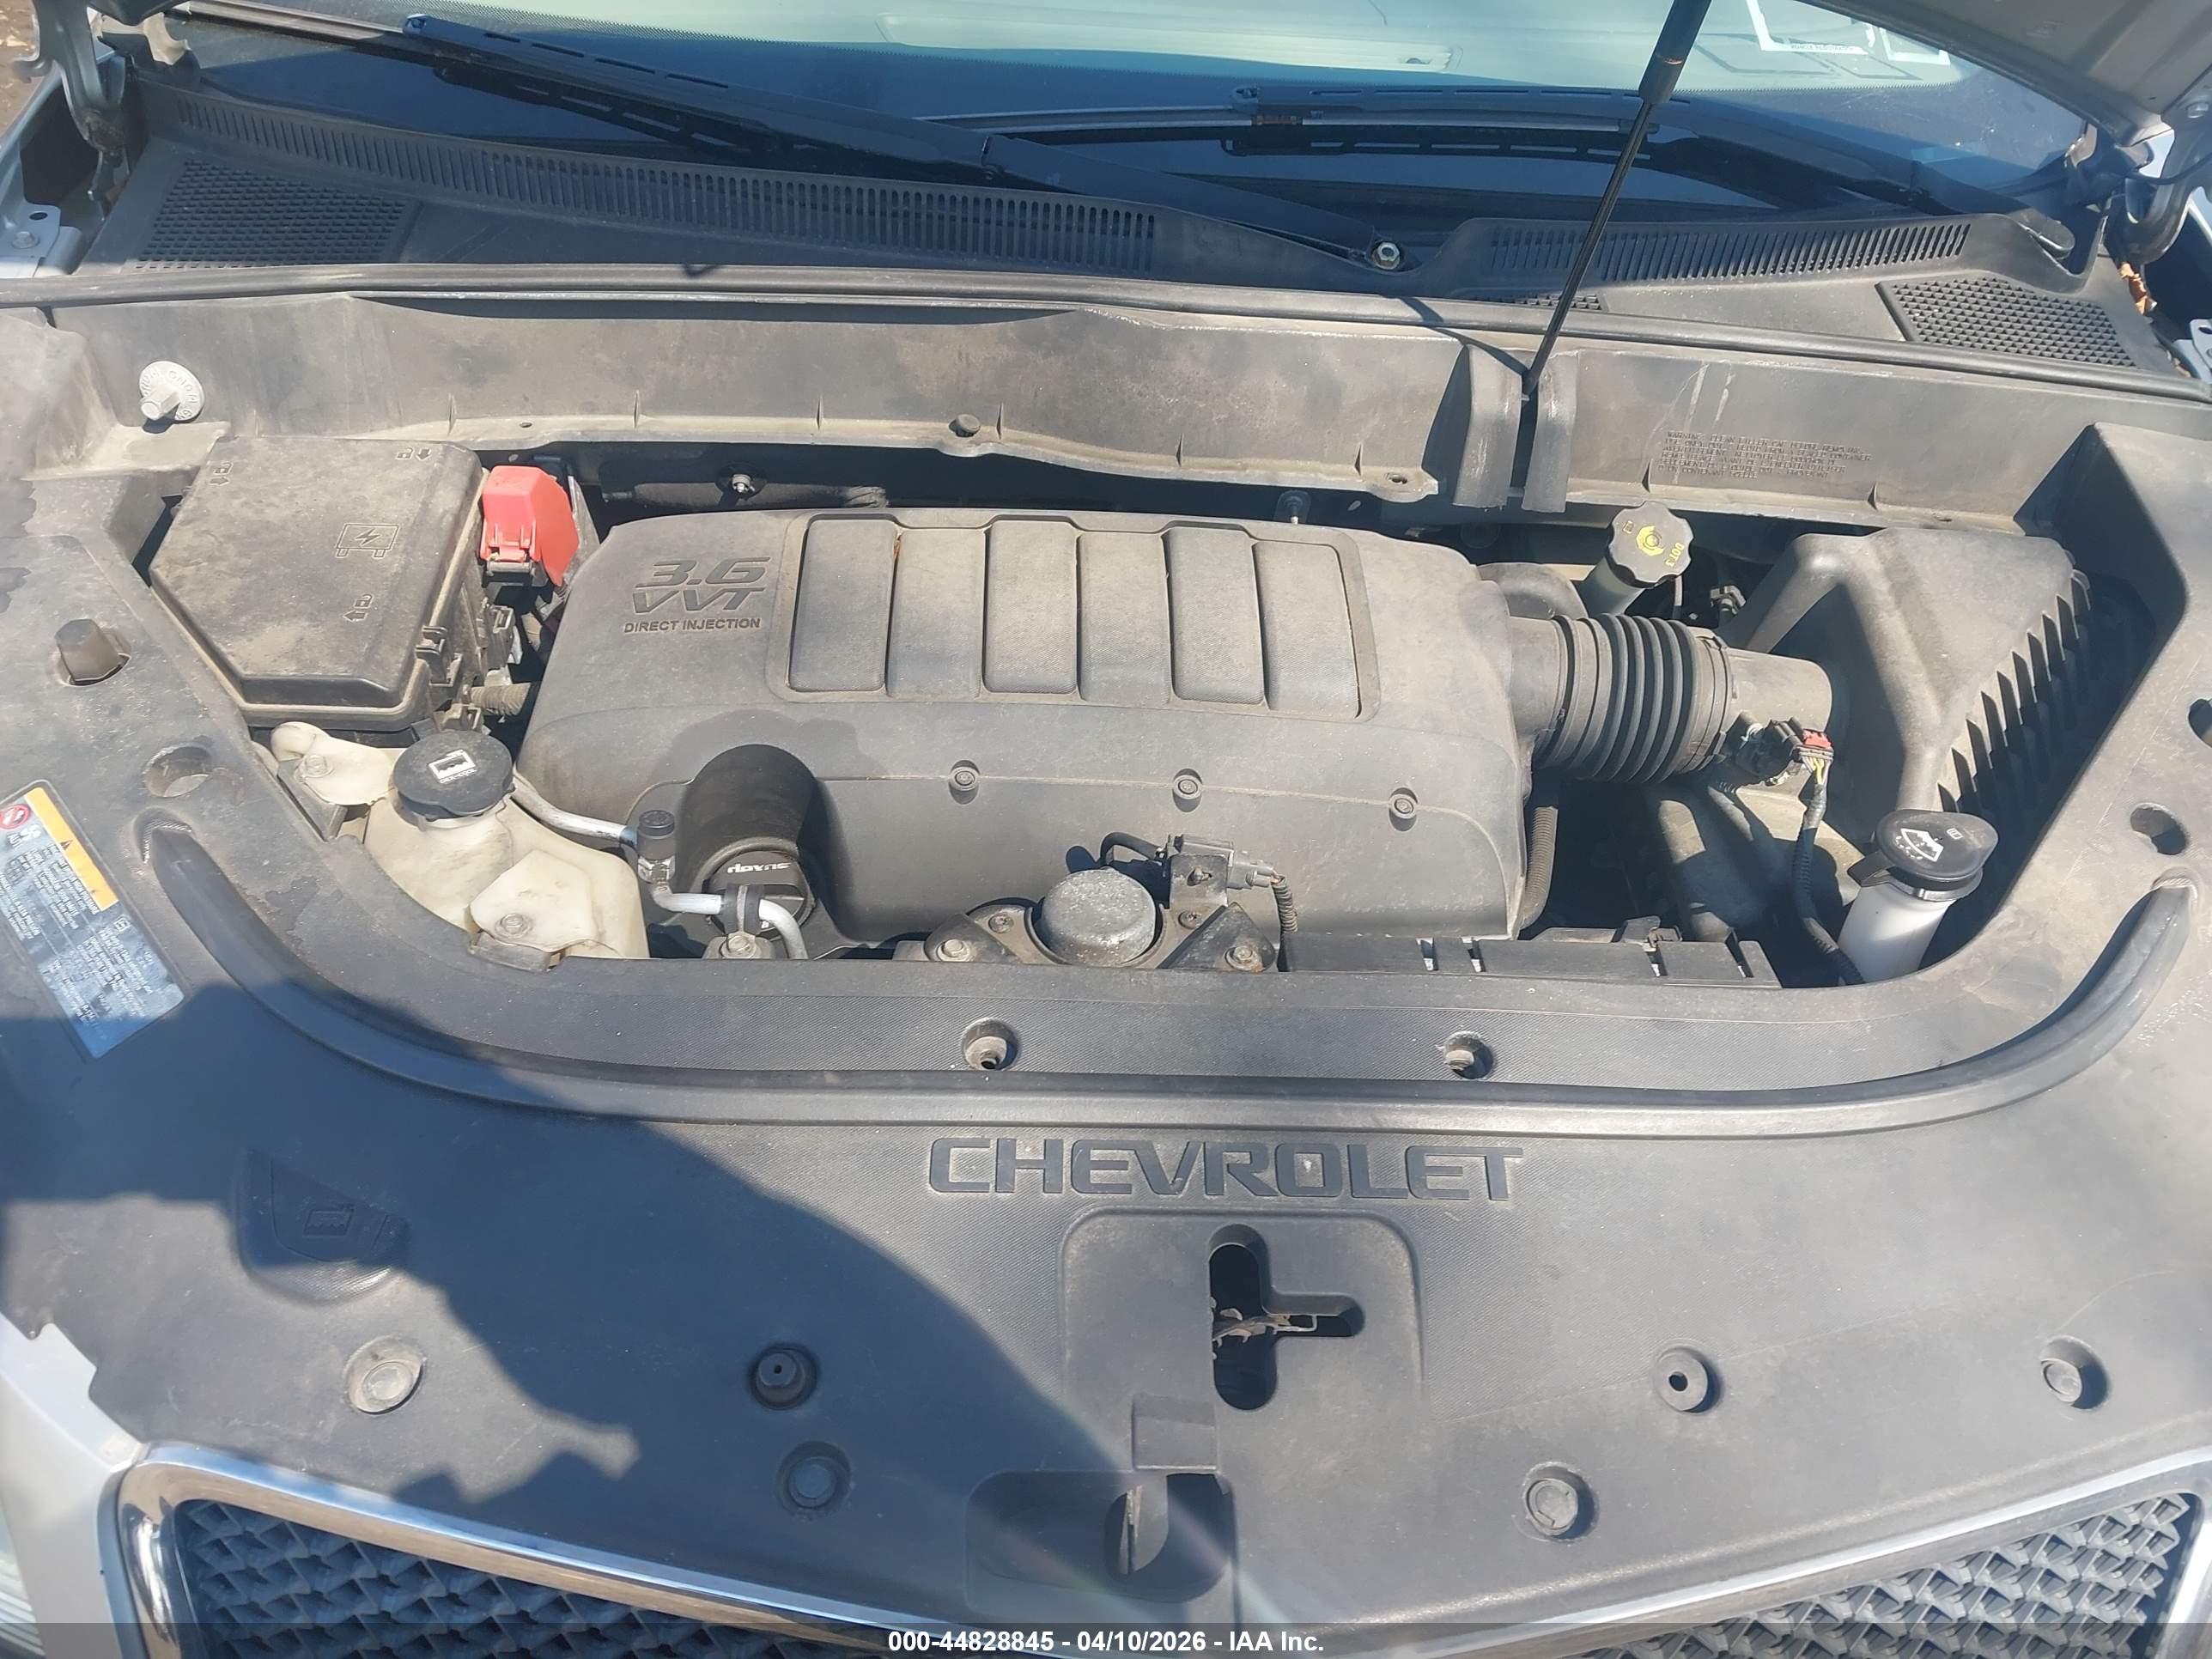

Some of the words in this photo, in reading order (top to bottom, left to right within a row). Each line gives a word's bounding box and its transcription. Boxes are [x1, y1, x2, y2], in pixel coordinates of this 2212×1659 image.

[1669, 542, 1685, 562] DOT
[635, 557, 770, 588] 3.6
[633, 587, 766, 614] VVT
[623, 620, 679, 634] DIRECT
[682, 617, 762, 631] INJECTION
[929, 1137, 1524, 1200] CHEVROLET
